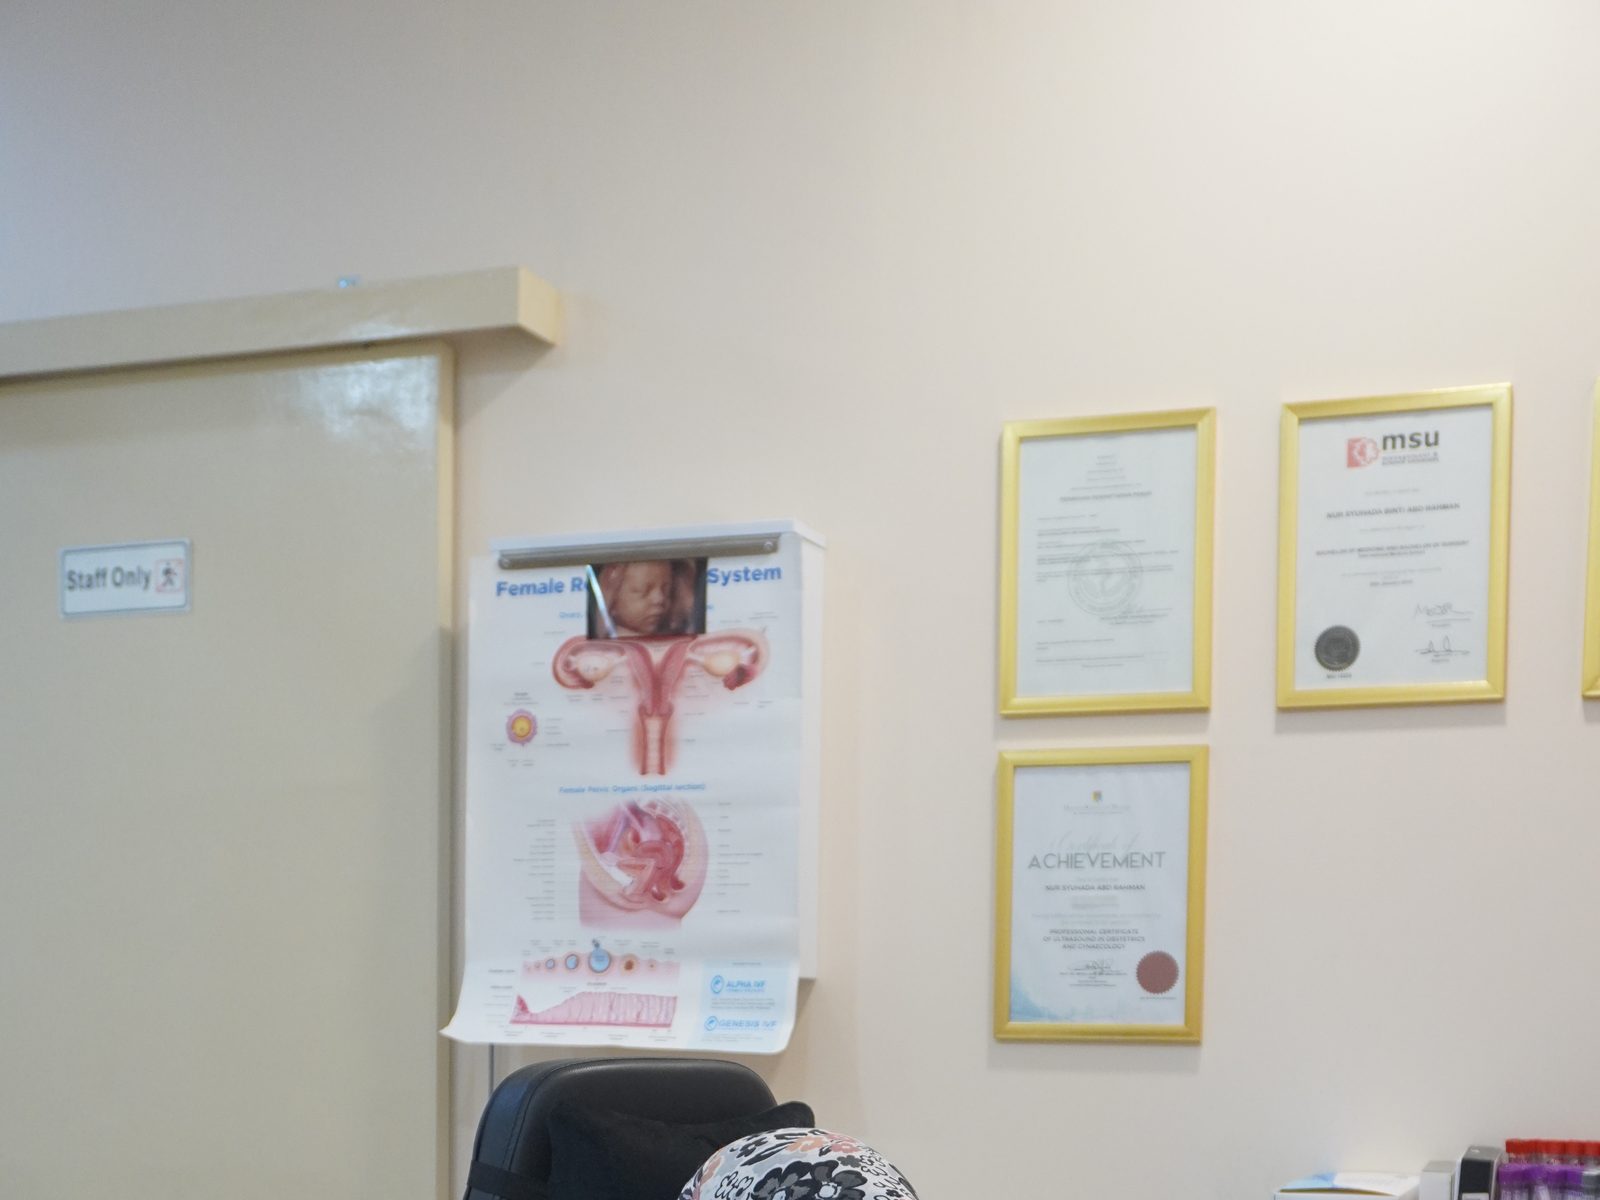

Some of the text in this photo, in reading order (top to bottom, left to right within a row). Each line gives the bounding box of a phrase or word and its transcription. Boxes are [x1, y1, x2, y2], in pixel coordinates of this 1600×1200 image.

[1382, 430, 1440, 451] msu
[67, 565, 152, 592] Staff Only
[496, 577, 565, 597] Female
[707, 566, 782, 587] System
[1027, 851, 1167, 870] ACHIEVEMENT
